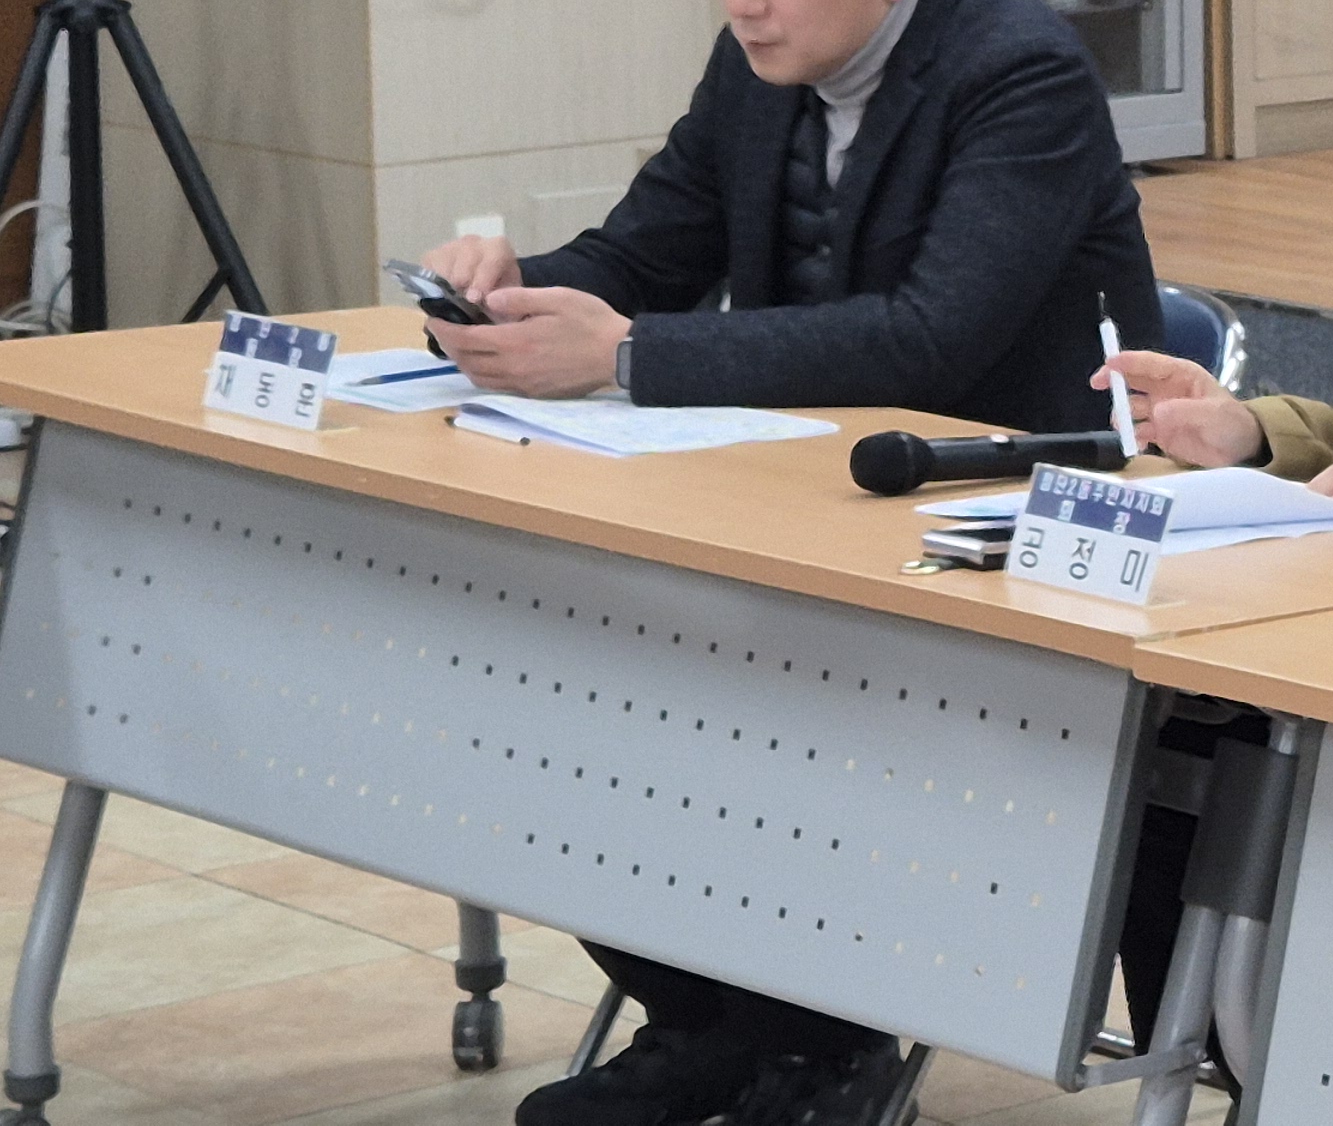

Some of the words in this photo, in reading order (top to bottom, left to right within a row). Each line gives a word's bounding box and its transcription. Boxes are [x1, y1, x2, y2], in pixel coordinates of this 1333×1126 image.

[1018, 526, 1046, 569] 공
[1068, 536, 1097, 581] 정
[1119, 548, 1149, 593] 미
